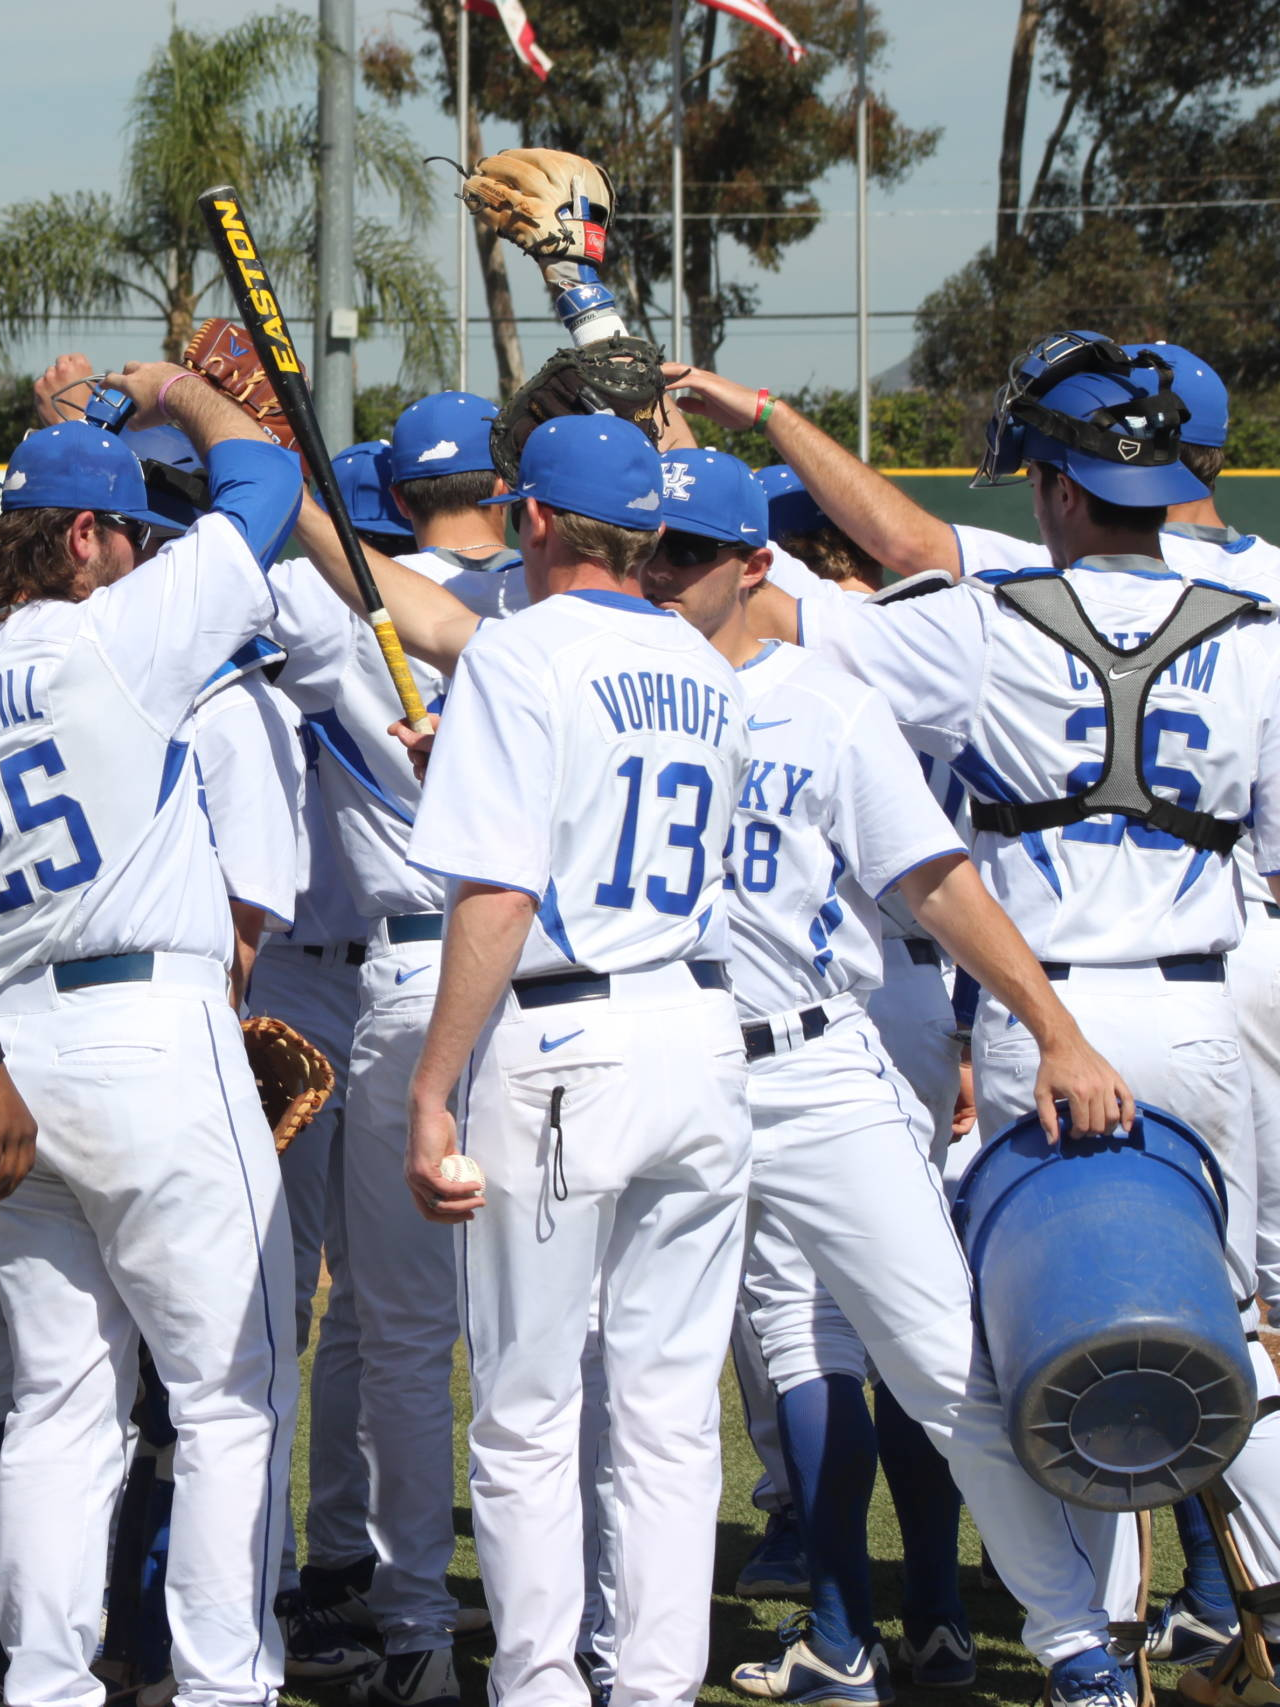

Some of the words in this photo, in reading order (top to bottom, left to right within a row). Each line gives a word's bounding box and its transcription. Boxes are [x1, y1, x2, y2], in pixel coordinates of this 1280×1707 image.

[214, 200, 300, 373] EASTON
[591, 671, 729, 748] VORHOFF
[1061, 706, 1210, 850] 26
[595, 755, 713, 917] 13
